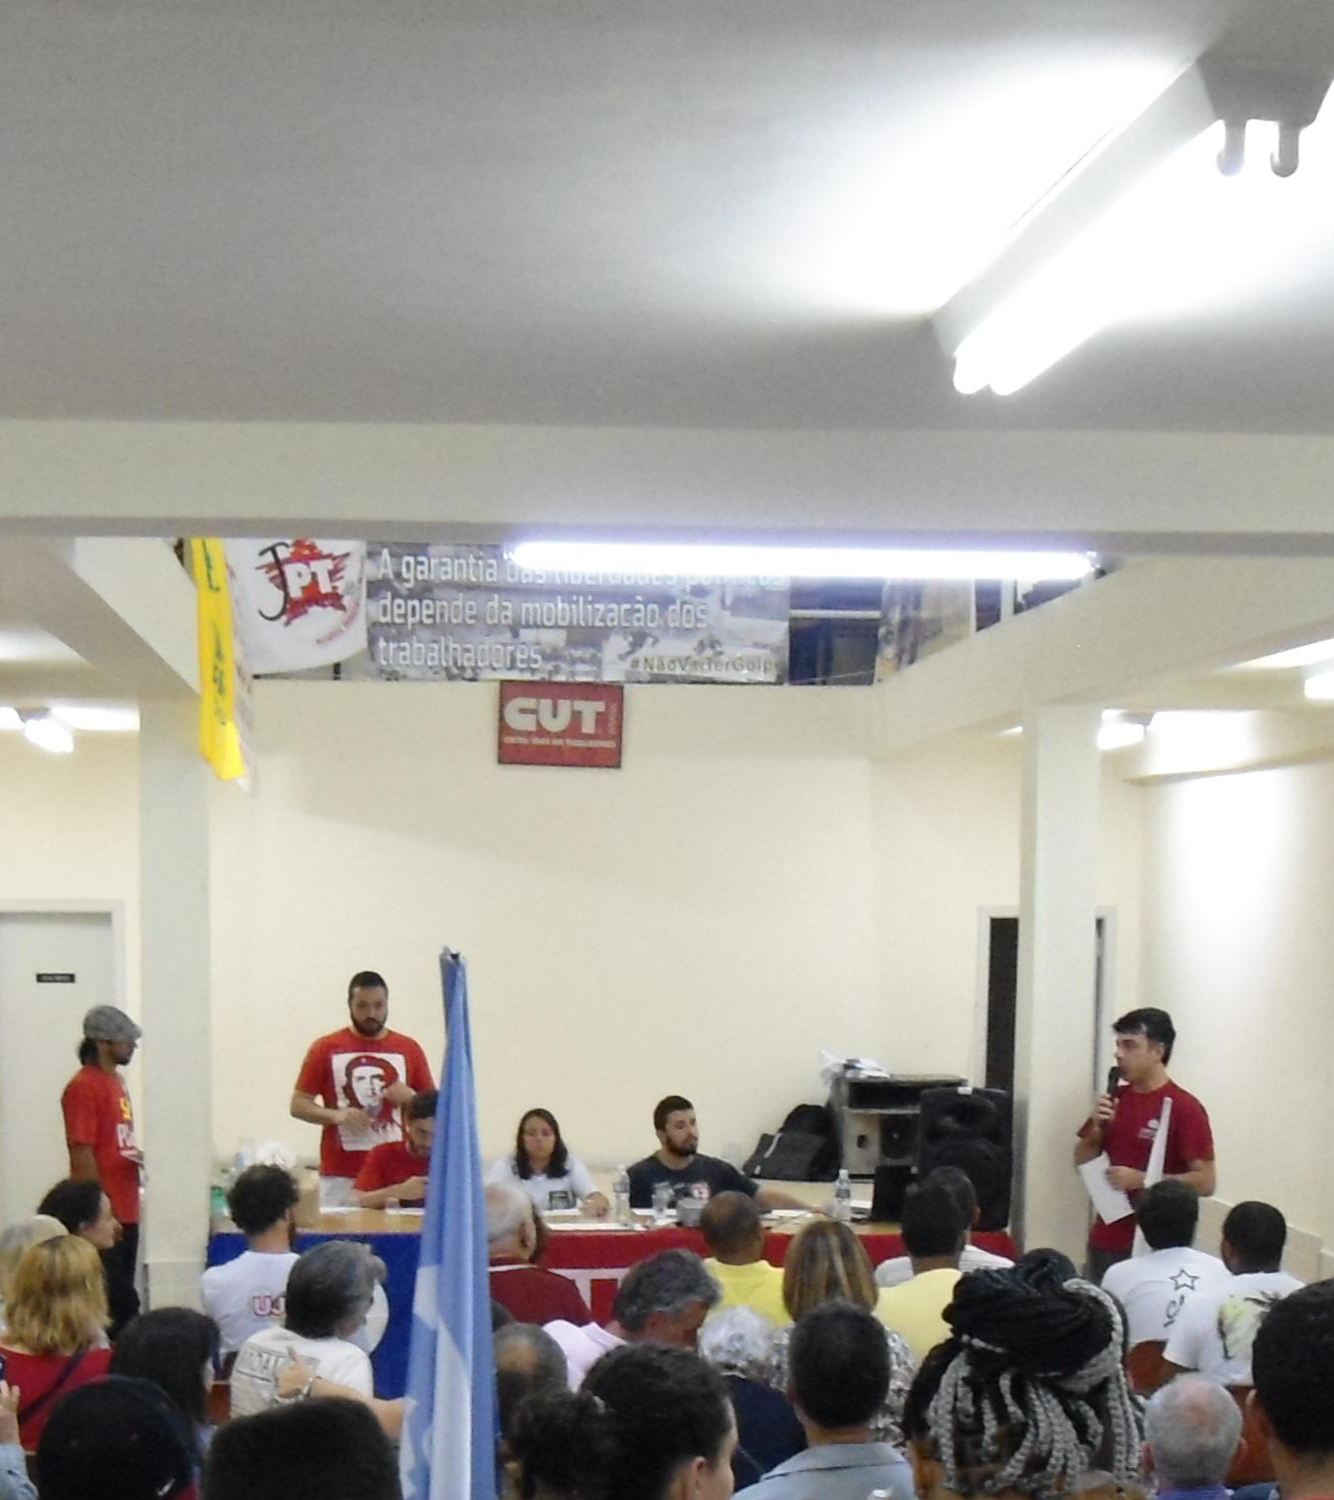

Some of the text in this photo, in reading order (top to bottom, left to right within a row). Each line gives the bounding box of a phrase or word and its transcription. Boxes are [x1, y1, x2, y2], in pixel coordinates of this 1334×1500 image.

[378, 549, 394, 582] A
[402, 550, 499, 588] garantia
[378, 595, 477, 627] depende
[486, 595, 513, 626] da
[668, 598, 709, 630] dos
[378, 636, 543, 670] trabalhadores
[504, 697, 607, 734] CUT
[252, 1295, 287, 1316] UJ
